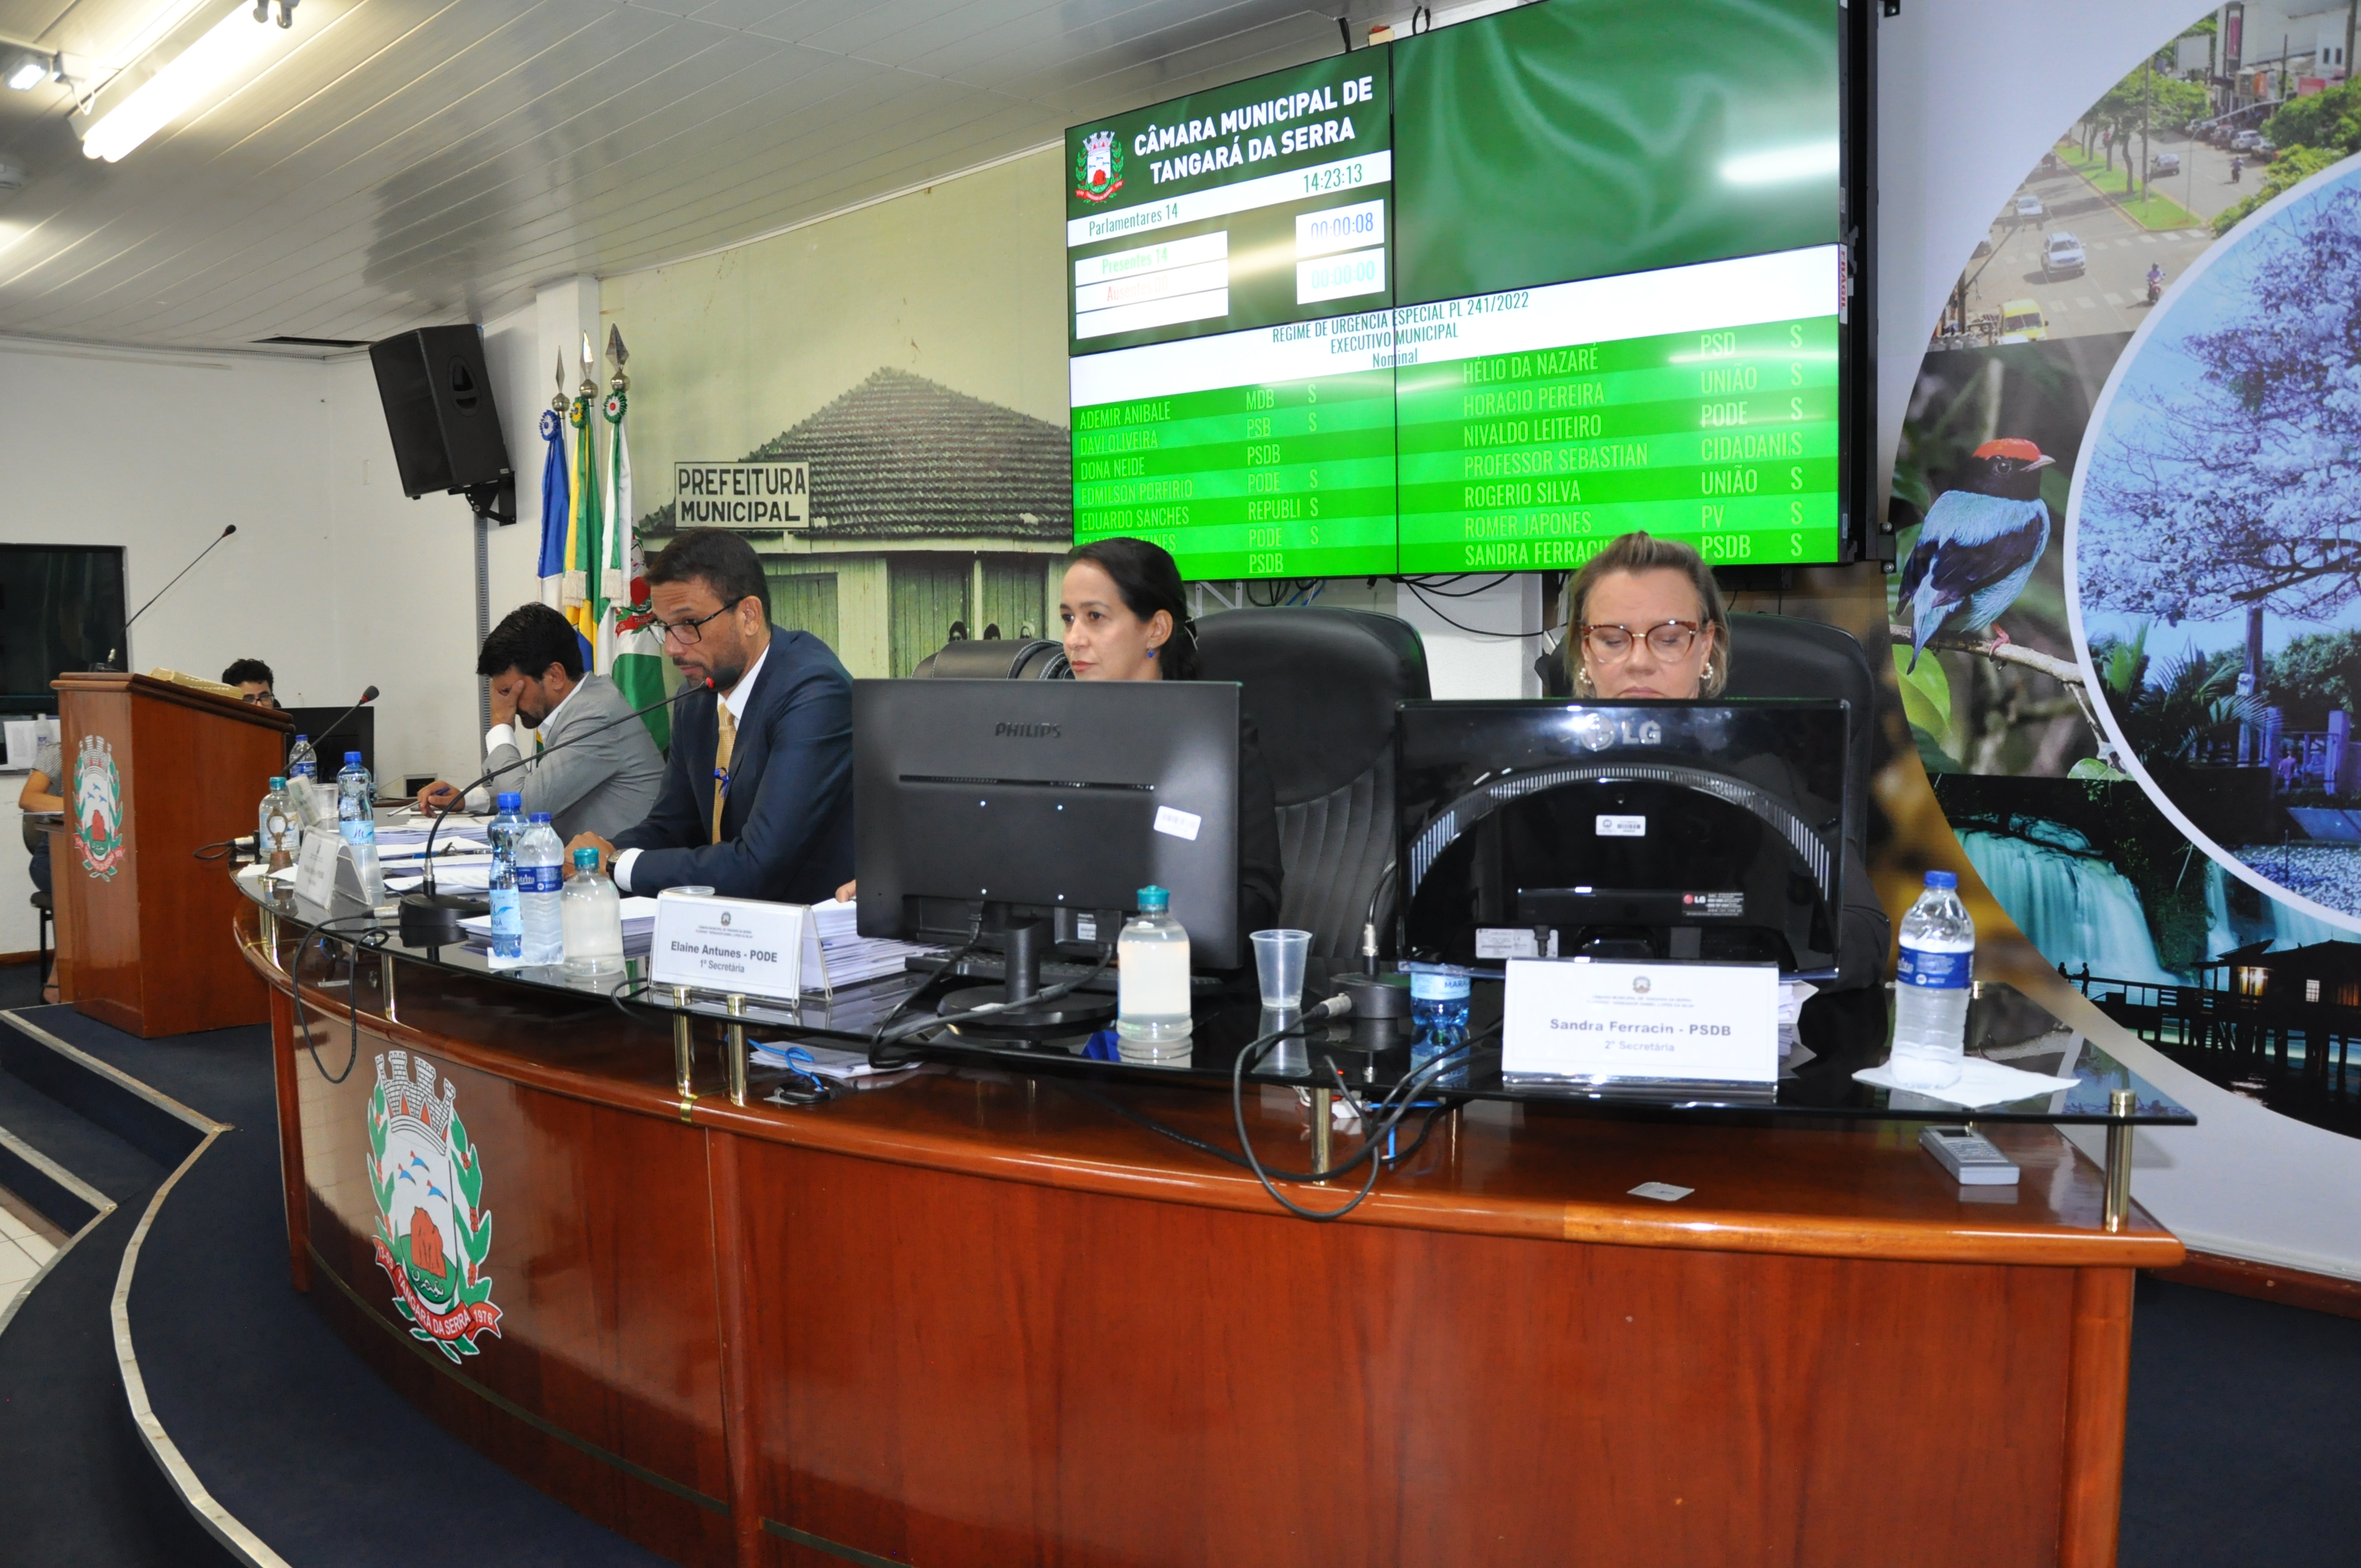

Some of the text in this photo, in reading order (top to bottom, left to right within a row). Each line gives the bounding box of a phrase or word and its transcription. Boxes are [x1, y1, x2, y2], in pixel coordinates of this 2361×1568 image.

[1134, 75, 1373, 156] CÂMARA MUNICIPAL DE
[1150, 117, 1356, 185] TANGARÁ DA SERRA
[1303, 164, 1363, 193] 14:23:13
[1089, 202, 1178, 237] Parlamentares 14
[1311, 212, 1373, 241] 00:00:08
[1102, 247, 1168, 274] Presentes 14
[1312, 260, 1374, 289] 00:00:00
[1107, 281, 1152, 301] Ausentes
[1273, 291, 1529, 343] REGIME DE URGÊNCIA ESPECIAL PL 241/2022
[1331, 323, 1459, 354] EXECUTIVO MUNICIPAL
[1373, 347, 1418, 368] Nominal
[1463, 324, 1803, 384] HÉLIO DA NAZARÉ PSD S
[1464, 362, 1803, 417] HORACIO PEREIRA UNIÃO S
[1080, 384, 1317, 429] ADEMIR ANIBALE MDB S
[1464, 396, 1803, 447] NIVALDO LEITEIRO PODE S
[1080, 412, 1317, 455] DAVI OLIVEIRA PSB S
[1081, 444, 1281, 480] DONA NEIDE PSDB
[1465, 449, 1553, 478] PROFESSOR
[1558, 443, 1649, 471] SEBASTIAN
[1701, 432, 1791, 461] CIDADANI
[678, 467, 806, 496] PREFEITURA
[1081, 469, 1318, 505] EDMILSON PORFIRIO PODE S
[1465, 465, 1803, 508] ROGERIO SILVA UNIÃO S
[681, 500, 801, 522] MUNICIPAL
[1082, 497, 1319, 531] EDUARDO SANCHES REPUBLI S
[1465, 500, 1803, 538] ROMER JAPONES PV S
[1249, 527, 1282, 548] PODE
[1310, 525, 1319, 545] S
[1465, 543, 1528, 566] SANDRA
[1702, 535, 1751, 560] PSDB
[1791, 532, 1803, 557] S
[1249, 553, 1283, 574] PSDB
[994, 722, 1062, 738] PHILIPS
[1622, 720, 1661, 744] LG
[671, 941, 699, 953] Elaine
[702, 945, 741, 959] Antunes
[750, 950, 777, 962] PODE
[708, 960, 744, 973] Secretária
[1550, 1019, 1603, 1031] Sandra
[1609, 1021, 1674, 1034] Ferracin
[1689, 1024, 1731, 1036] PSDB
[1619, 1041, 1675, 1052] Secretária
[377, 1245, 394, 1270] 13-05
[398, 1270, 471, 1336] TANGARÁ DA SERRA
[474, 1310, 493, 1326] 1976
